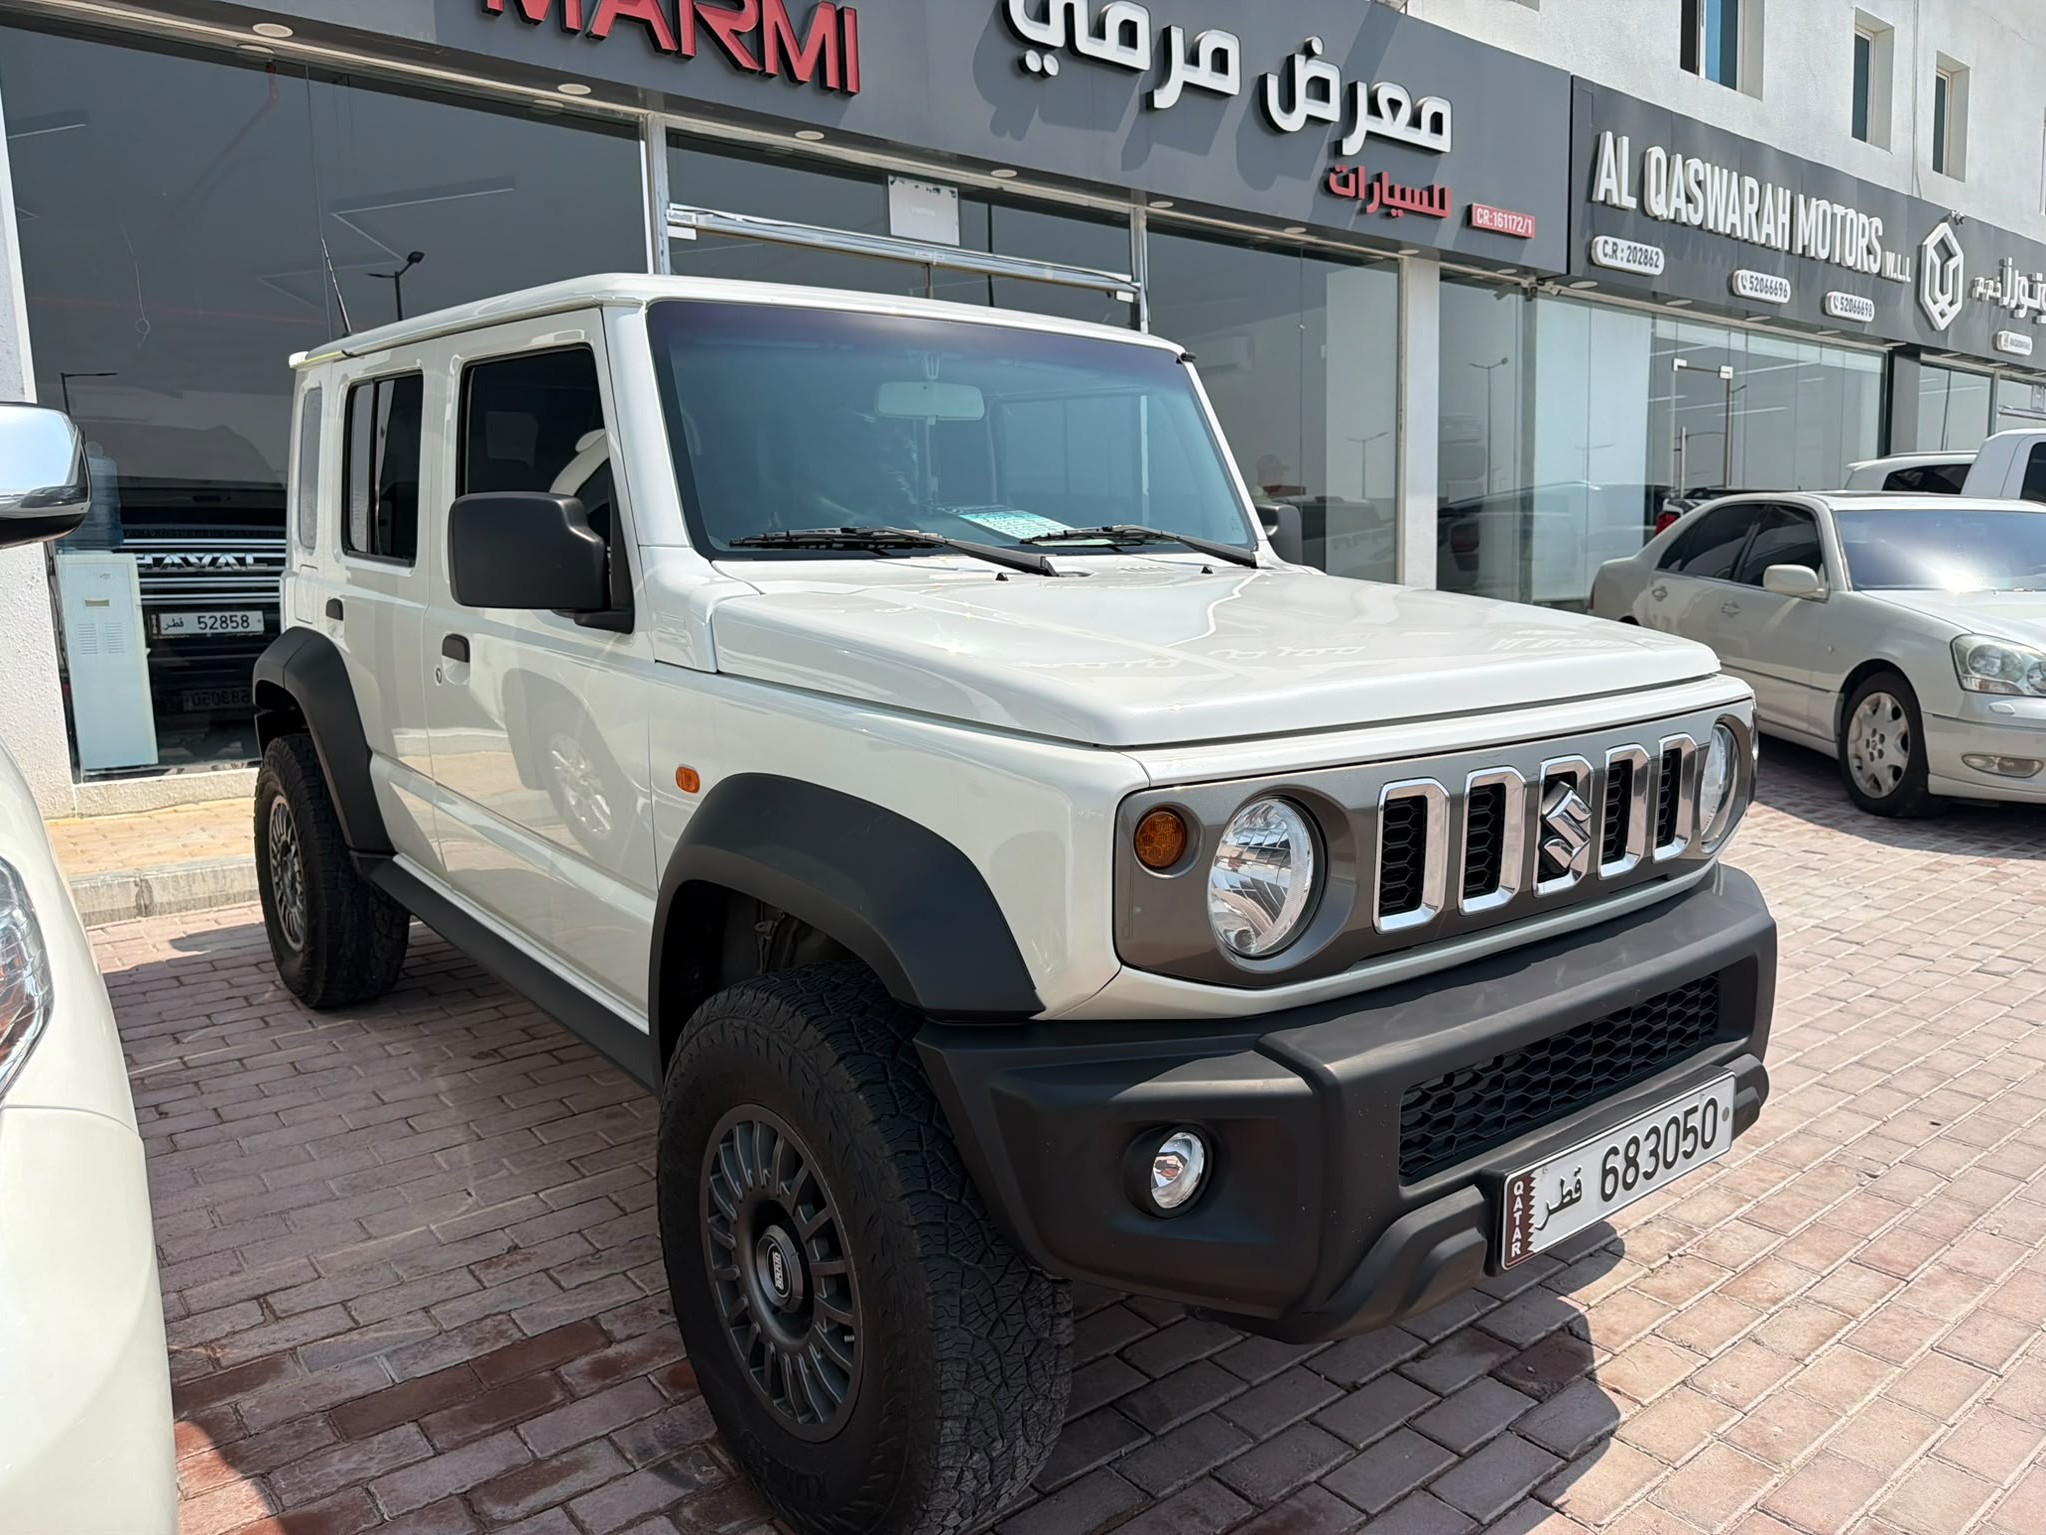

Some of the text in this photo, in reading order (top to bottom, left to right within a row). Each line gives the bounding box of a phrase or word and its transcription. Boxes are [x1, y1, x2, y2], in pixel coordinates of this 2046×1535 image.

[1261, 36, 1452, 156] معرض
[1329, 164, 1452, 218] للسيارات
[1592, 131, 1637, 210] AL
[1644, 146, 1792, 251] QASWARAH
[1793, 193, 1884, 275] MOTORS
[1625, 244, 1660, 269] 202862
[1749, 274, 1788, 299] 52066696
[163, 617, 184, 631] قطر
[197, 614, 250, 631] 52858
[1599, 1096, 1718, 1203] 683050
[1510, 1180, 1525, 1256] QATAR
[1534, 1166, 1583, 1231] قطر
